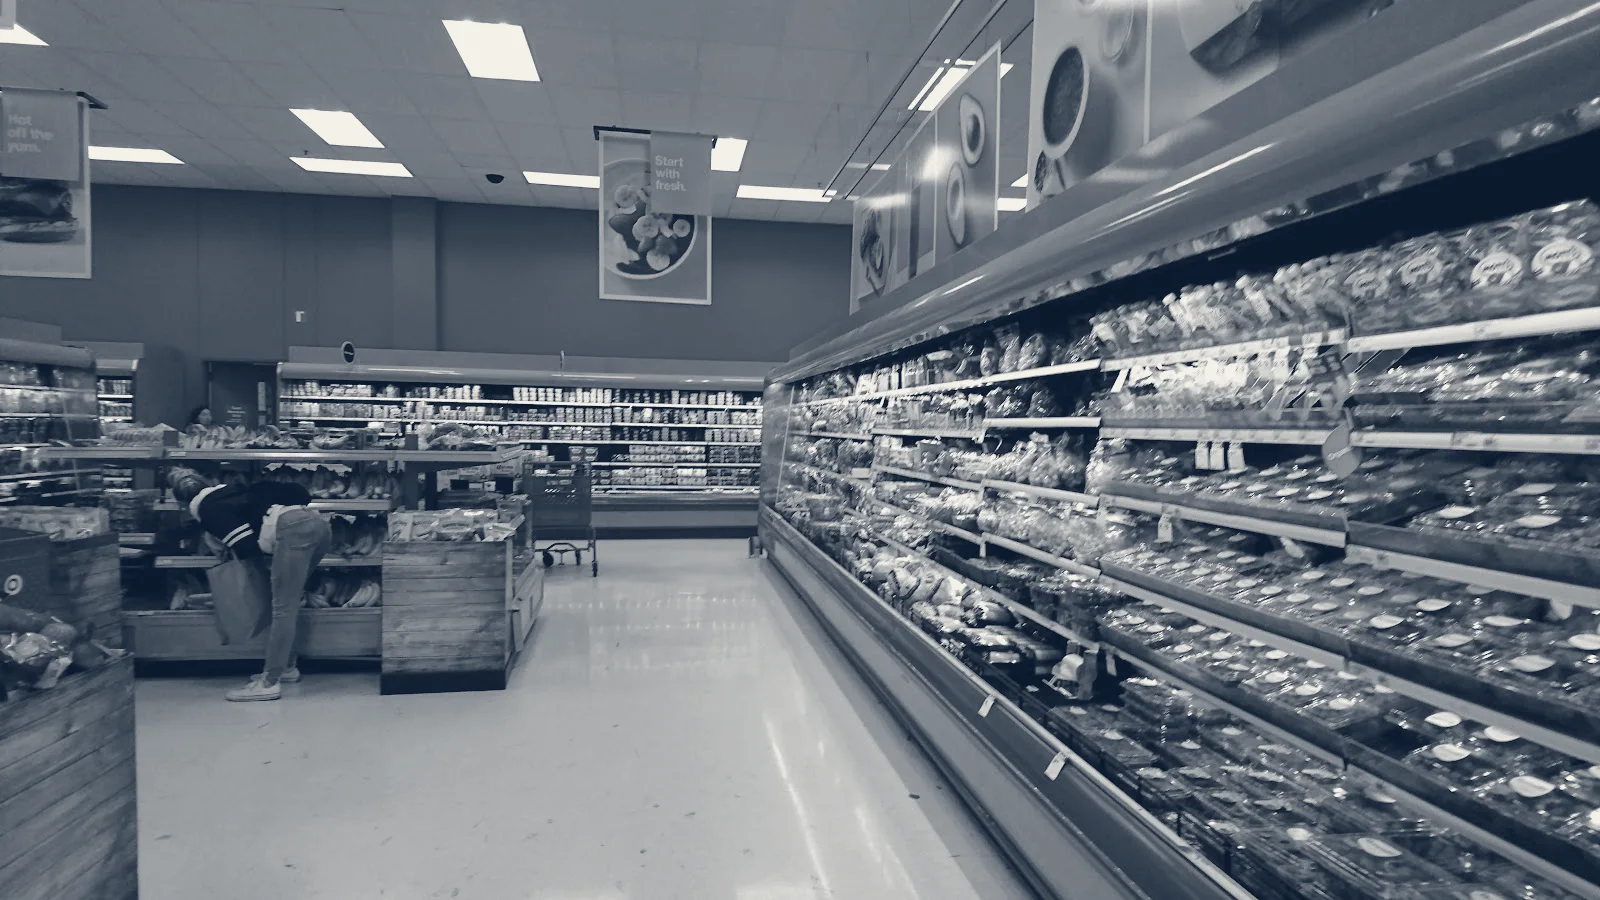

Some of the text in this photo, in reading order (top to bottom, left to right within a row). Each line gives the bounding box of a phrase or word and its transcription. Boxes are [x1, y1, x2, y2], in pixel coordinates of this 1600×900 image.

[8, 114, 33, 126] Hot
[7, 125, 54, 141] off the
[7, 140, 41, 153] yum.
[655, 155, 684, 167] Start
[656, 168, 680, 179] with
[656, 179, 687, 192] fresh.
